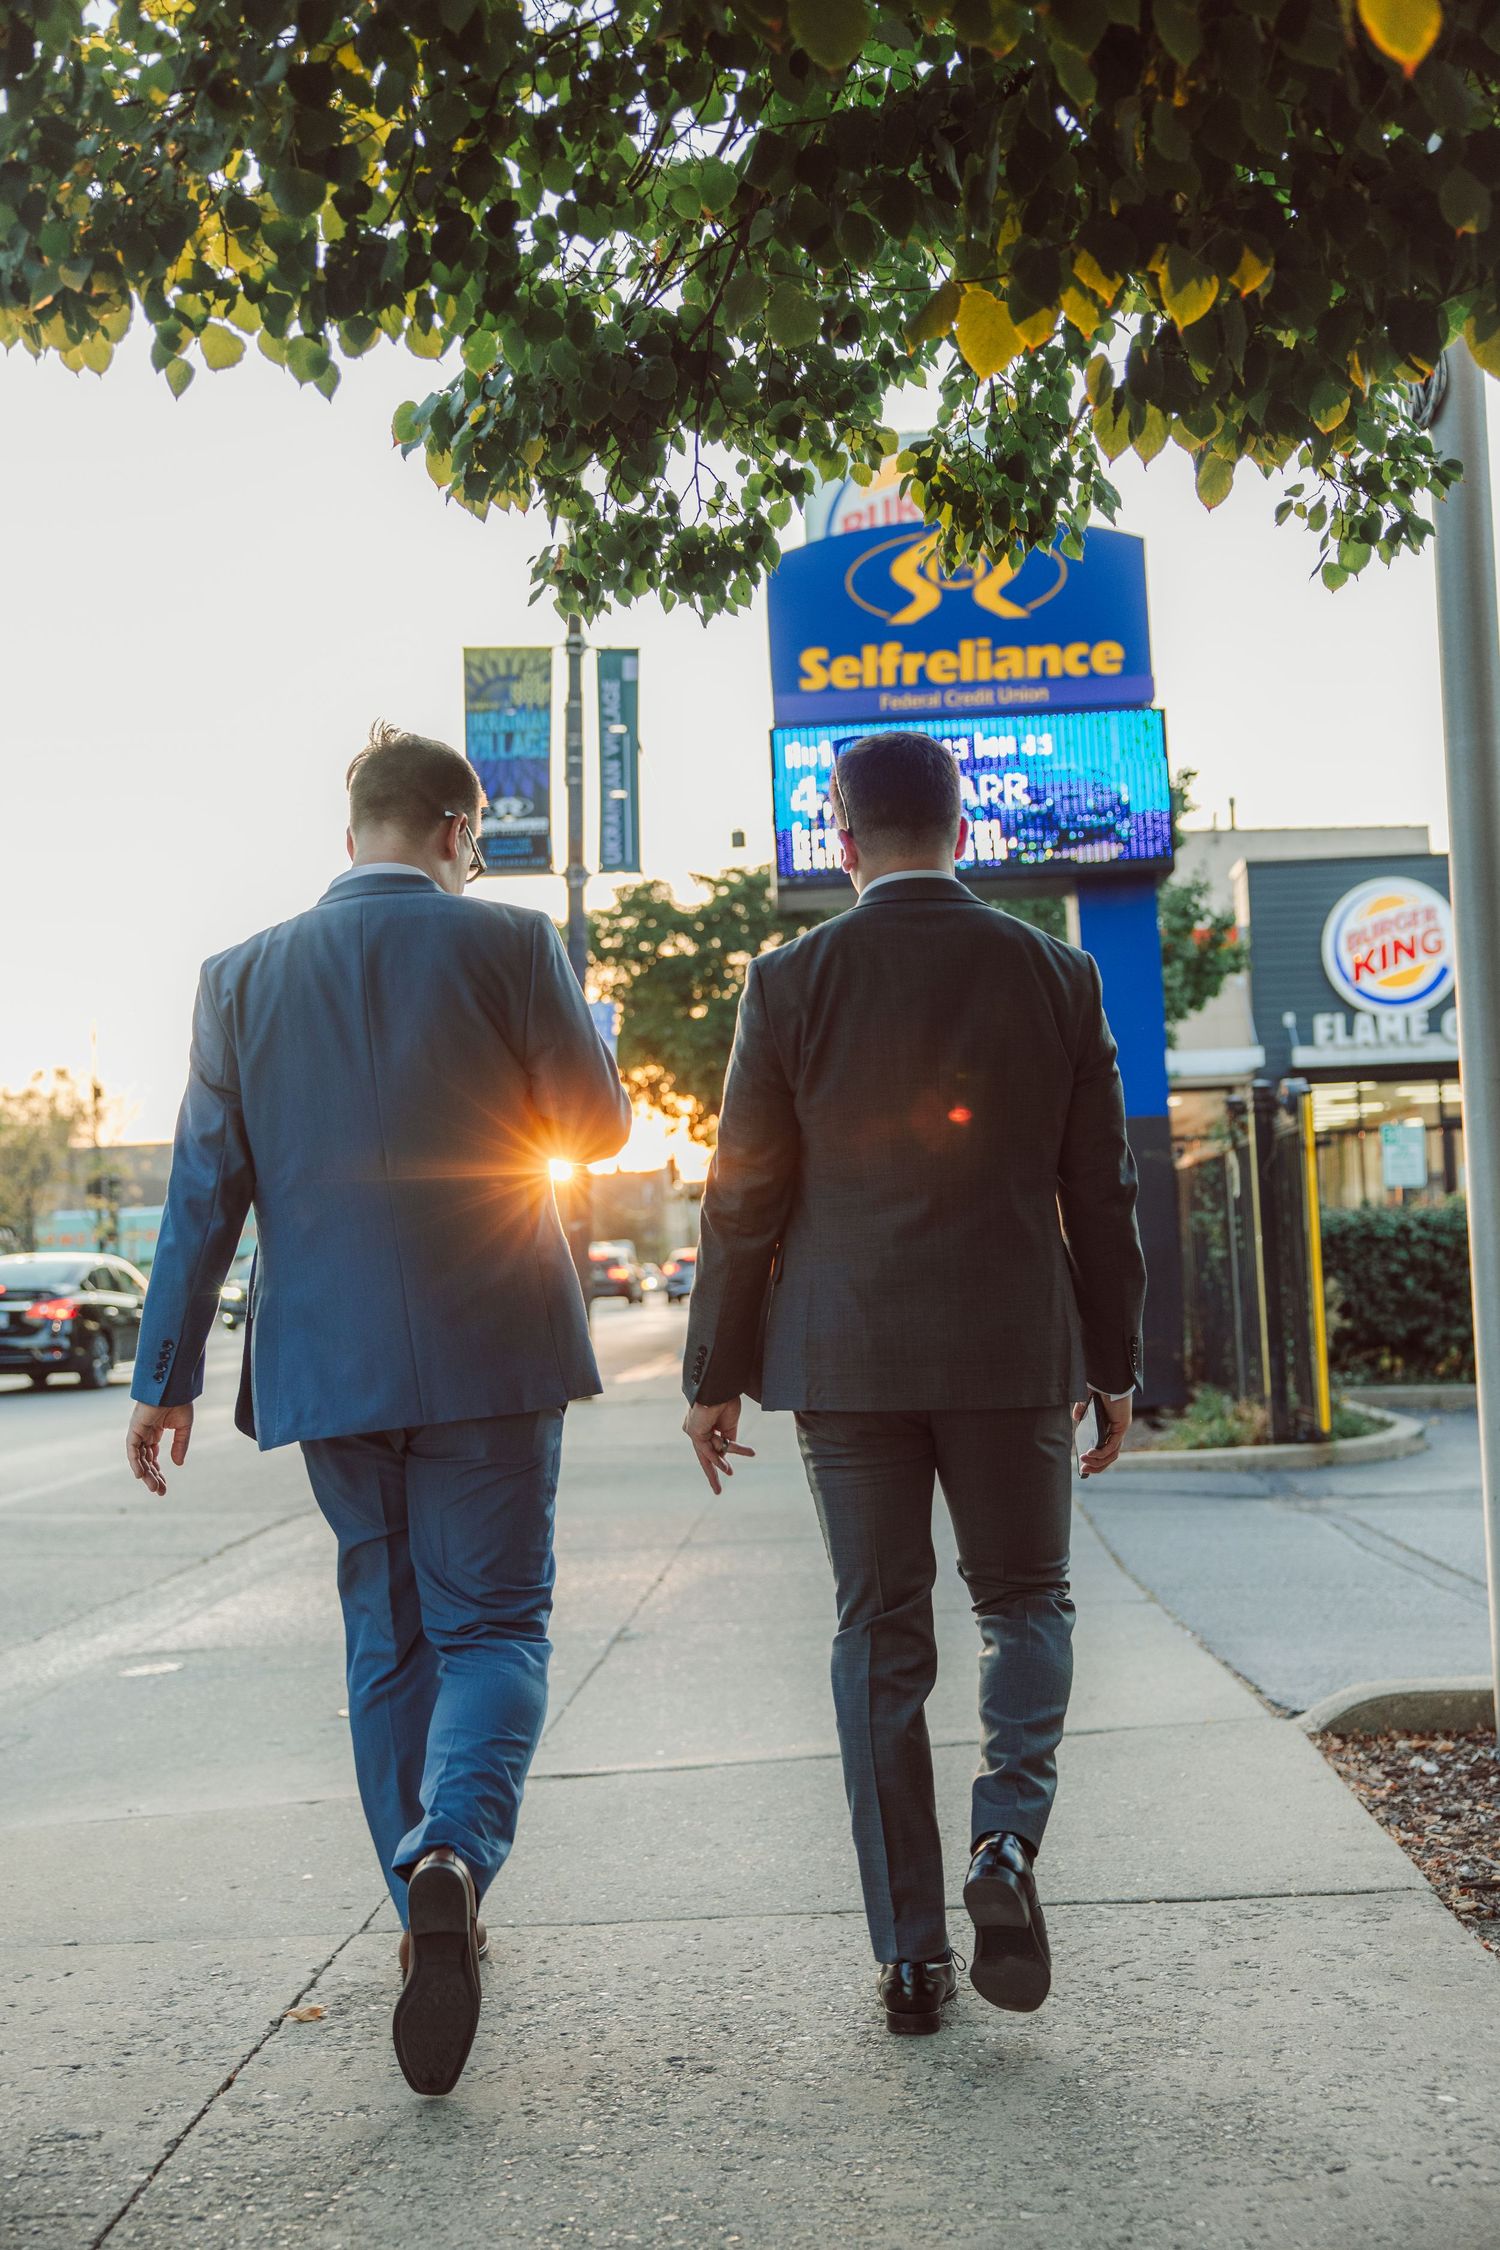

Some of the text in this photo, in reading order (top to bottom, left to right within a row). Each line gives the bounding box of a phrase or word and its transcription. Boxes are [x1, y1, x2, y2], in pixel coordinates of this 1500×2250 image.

[799, 637, 1126, 691] Selfreliance
[879, 685, 1050, 712] Federal Credit Union
[1352, 926, 1446, 983] KING
[1312, 1010, 1430, 1046] FLAME
